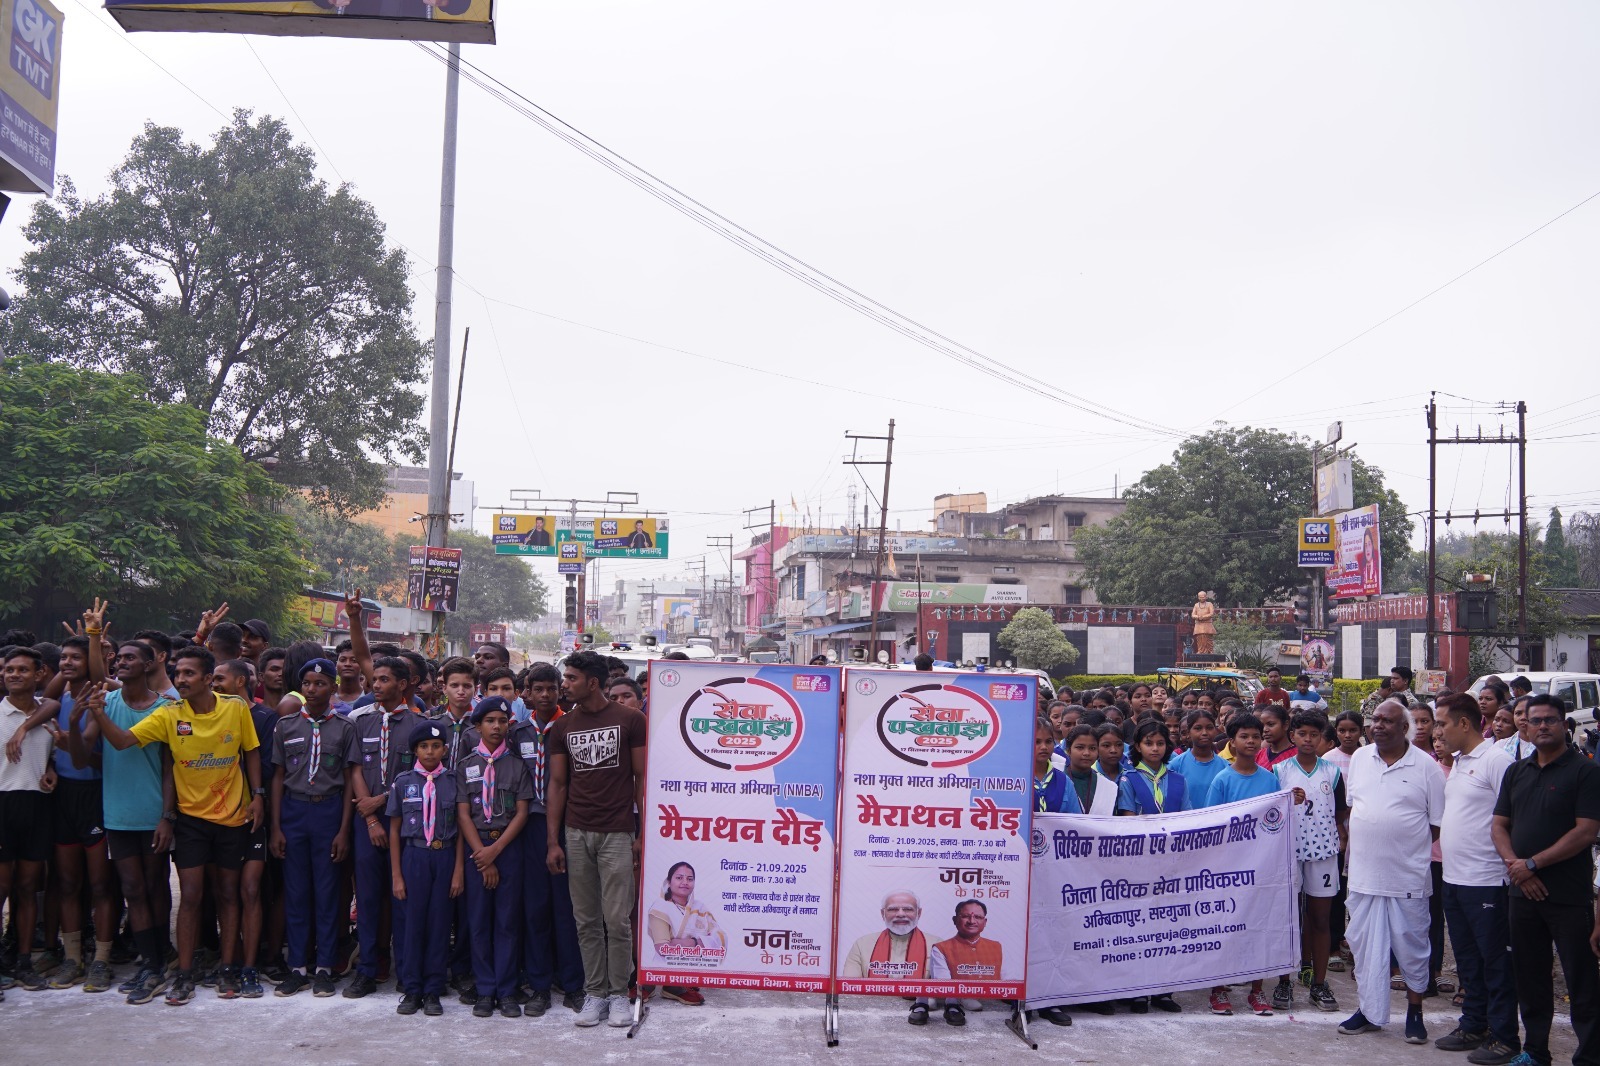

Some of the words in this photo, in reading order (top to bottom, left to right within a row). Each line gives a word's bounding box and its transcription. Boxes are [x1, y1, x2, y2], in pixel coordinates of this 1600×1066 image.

[15, 0, 57, 64] GK
[15, 44, 49, 91] TMT
[500, 516, 516, 526] GK
[602, 521, 616, 530] GK
[1305, 524, 1328, 535] GK
[562, 544, 578, 553] GK
[906, 590, 931, 598] Casrol
[713, 696, 774, 720] सेवा
[910, 702, 970, 722] सेवा
[571, 730, 616, 746] OSAKA
[725, 736, 757, 746] 2025
[922, 737, 954, 746] 2025
[594, 744, 614, 762] WEAR
[660, 780, 681, 792] नशा
[684, 780, 708, 796] मुक्त
[710, 782, 736, 794] भारत
[740, 780, 781, 796] अभियान
[784, 783, 824, 798] (NMBA)
[854, 774, 876, 786] नशा
[878, 774, 904, 790] मुक्त
[907, 774, 934, 788] भारत
[938, 772, 980, 790] अभियान
[984, 777, 1026, 793] (NMBA)
[856, 794, 964, 829] मैराथन
[970, 798, 1022, 837] दौड़
[1304, 800, 1314, 817] 2
[658, 804, 766, 844] मैराथन
[772, 808, 824, 852] दौड़
[1098, 834, 1146, 858] साक्षरता
[1149, 827, 1166, 855] एवं
[1226, 814, 1258, 844] शिविर
[868, 834, 890, 844] दिनांक
[896, 838, 939, 848] 21.09.2025,
[978, 840, 994, 848] 7.30
[995, 838, 1006, 848] बजे
[720, 859, 748, 872] दिनांक
[756, 863, 807, 874] 21.09.2025
[768, 876, 784, 884] 7.30
[786, 874, 796, 884] बजे
[938, 866, 984, 886] जन
[1322, 874, 1332, 888] 2
[955, 885, 967, 898] के
[972, 888, 984, 898] 15
[988, 886, 1010, 899] दिन
[1062, 884, 1097, 907] जिला
[1101, 878, 1150, 902] विधिक
[1152, 876, 1180, 897] सेवा
[1185, 869, 1256, 894] प्राधिकरण
[1083, 908, 1146, 930] अम्बिकापुर,
[1149, 903, 1192, 924] सरगुजा
[743, 928, 792, 950] जन
[1073, 938, 1105, 952] Email
[1112, 922, 1247, 948] dlsa.surguja@gmail.com
[760, 950, 774, 965] के
[778, 954, 794, 966] 15
[797, 952, 821, 967] दिन
[1101, 952, 1136, 964] Phone
[1144, 940, 1222, 959] 07774-299120
[870, 962, 878, 970] श्री
[900, 962, 917, 970] मोदी
[646, 973, 666, 983] जिला
[669, 975, 700, 985] प्रशासन
[702, 976, 726, 986] समाज
[730, 978, 760, 987] कल्याण
[794, 980, 823, 992] सरगुजा
[842, 983, 862, 992] जिला
[866, 984, 894, 994] प्रशासन
[898, 984, 922, 994] समाज
[926, 986, 956, 994] कल्याण
[990, 987, 1018, 998] सरगुजा
